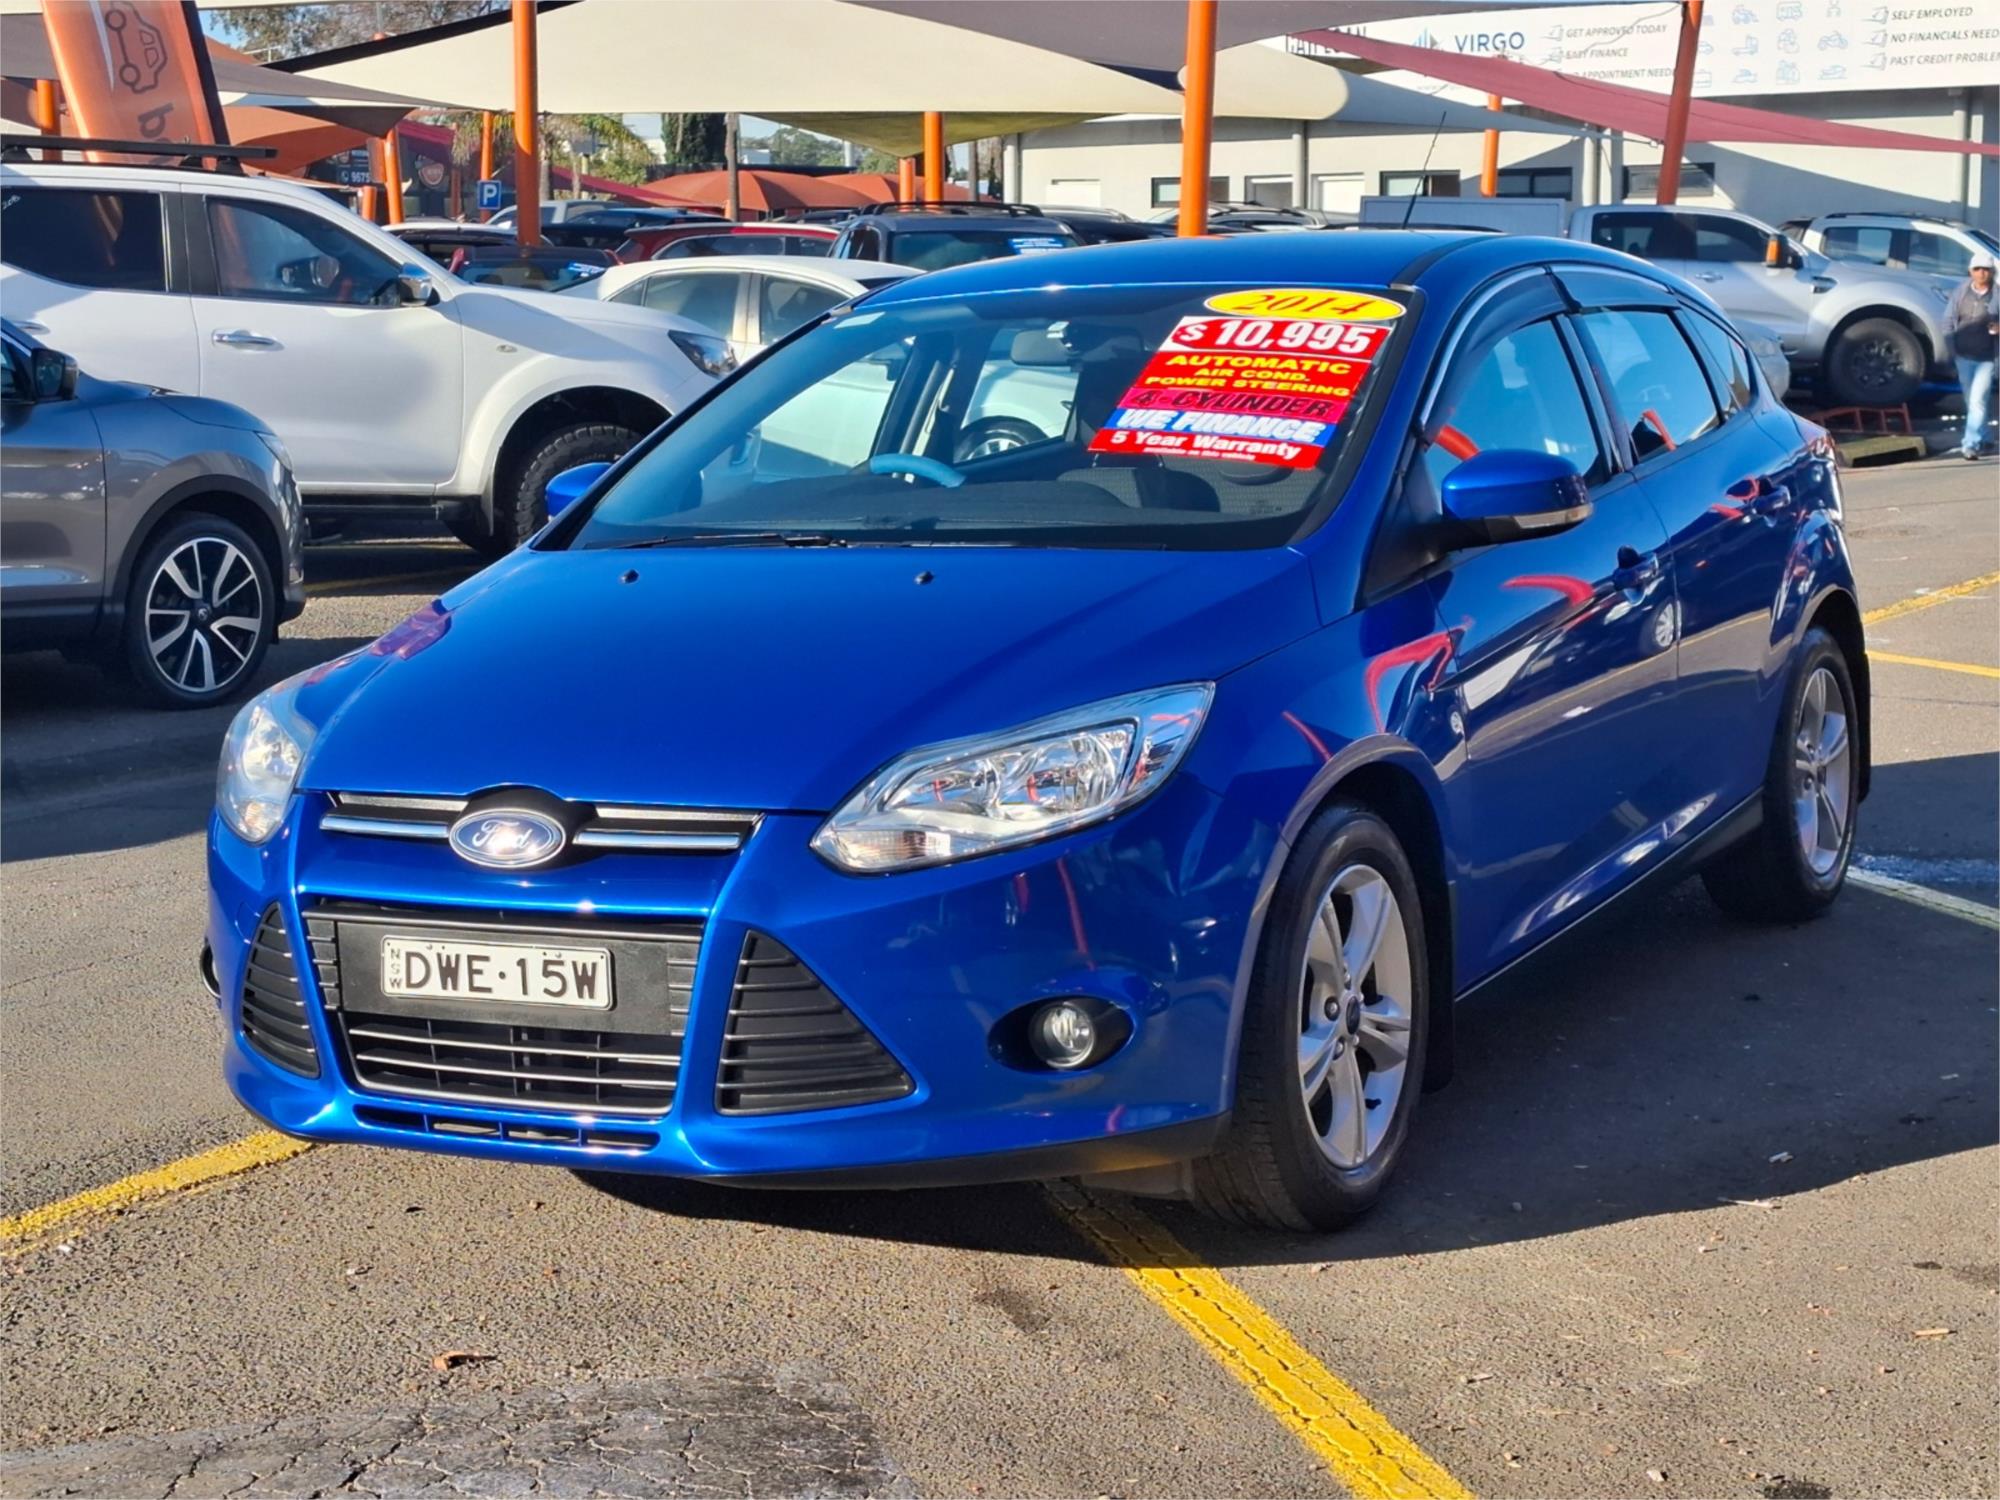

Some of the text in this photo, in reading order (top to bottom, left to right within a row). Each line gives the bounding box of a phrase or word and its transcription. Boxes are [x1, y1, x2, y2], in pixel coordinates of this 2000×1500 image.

[1892, 7, 1973, 20] SELF EMPLOYED
[1566, 28, 1584, 38] GET
[1636, 24, 1667, 34] TODAY
[1891, 33, 1907, 43] NO
[1908, 30, 1969, 42] FINANCIALS
[1455, 31, 1525, 53] VIRGO
[1589, 47, 1628, 58] FINANCE
[1890, 55, 1914, 66] PAST
[1916, 53, 1953, 65] CREDIT
[483, 184, 498, 205] P
[1231, 293, 1377, 315] 2014
[1179, 319, 1377, 353] $ 10,995
[1166, 354, 1353, 375] AUTOMATIC
[1194, 367, 1311, 382] AIR COND.
[1145, 376, 1351, 397] POWER STEERING
[1115, 408, 1328, 443] WE FINANCE
[1110, 430, 1129, 444] 5
[1134, 431, 1188, 447] Year
[1192, 434, 1302, 460] Warranty
